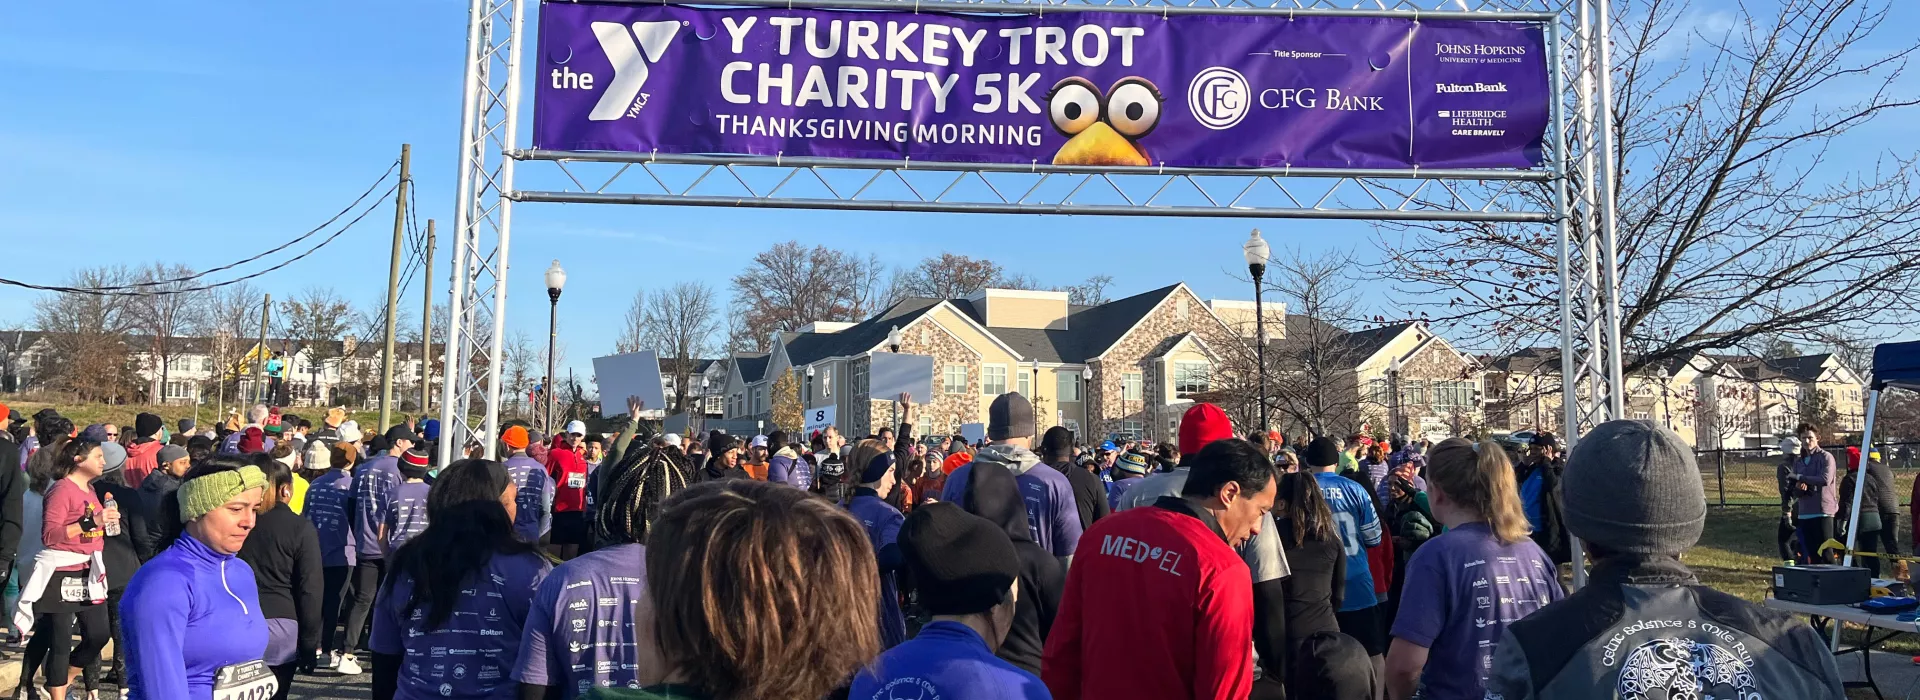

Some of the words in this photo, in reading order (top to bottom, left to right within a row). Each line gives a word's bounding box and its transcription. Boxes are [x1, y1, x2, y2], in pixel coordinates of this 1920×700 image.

[721, 16, 757, 54] Y
[769, 17, 987, 67] TURKEY
[999, 24, 1145, 67] TROT
[1435, 43, 1471, 55] JOHNS
[1474, 44, 1526, 55] HOPKINS
[1273, 50, 1290, 58] Title
[1291, 50, 1322, 59] Sponsor
[551, 66, 593, 90] the
[720, 61, 959, 114] CHARITY
[972, 72, 1041, 114] 5K
[1435, 83, 1474, 93] Fulton
[1475, 82, 1508, 92] Bank
[626, 91, 651, 120] YMCA
[1259, 88, 1317, 109] CFG
[1452, 110, 1507, 118] LIFEBRIDGE
[715, 114, 908, 143] THANKSGIVING
[916, 123, 1042, 147] MORNING
[815, 410, 825, 422] 8
